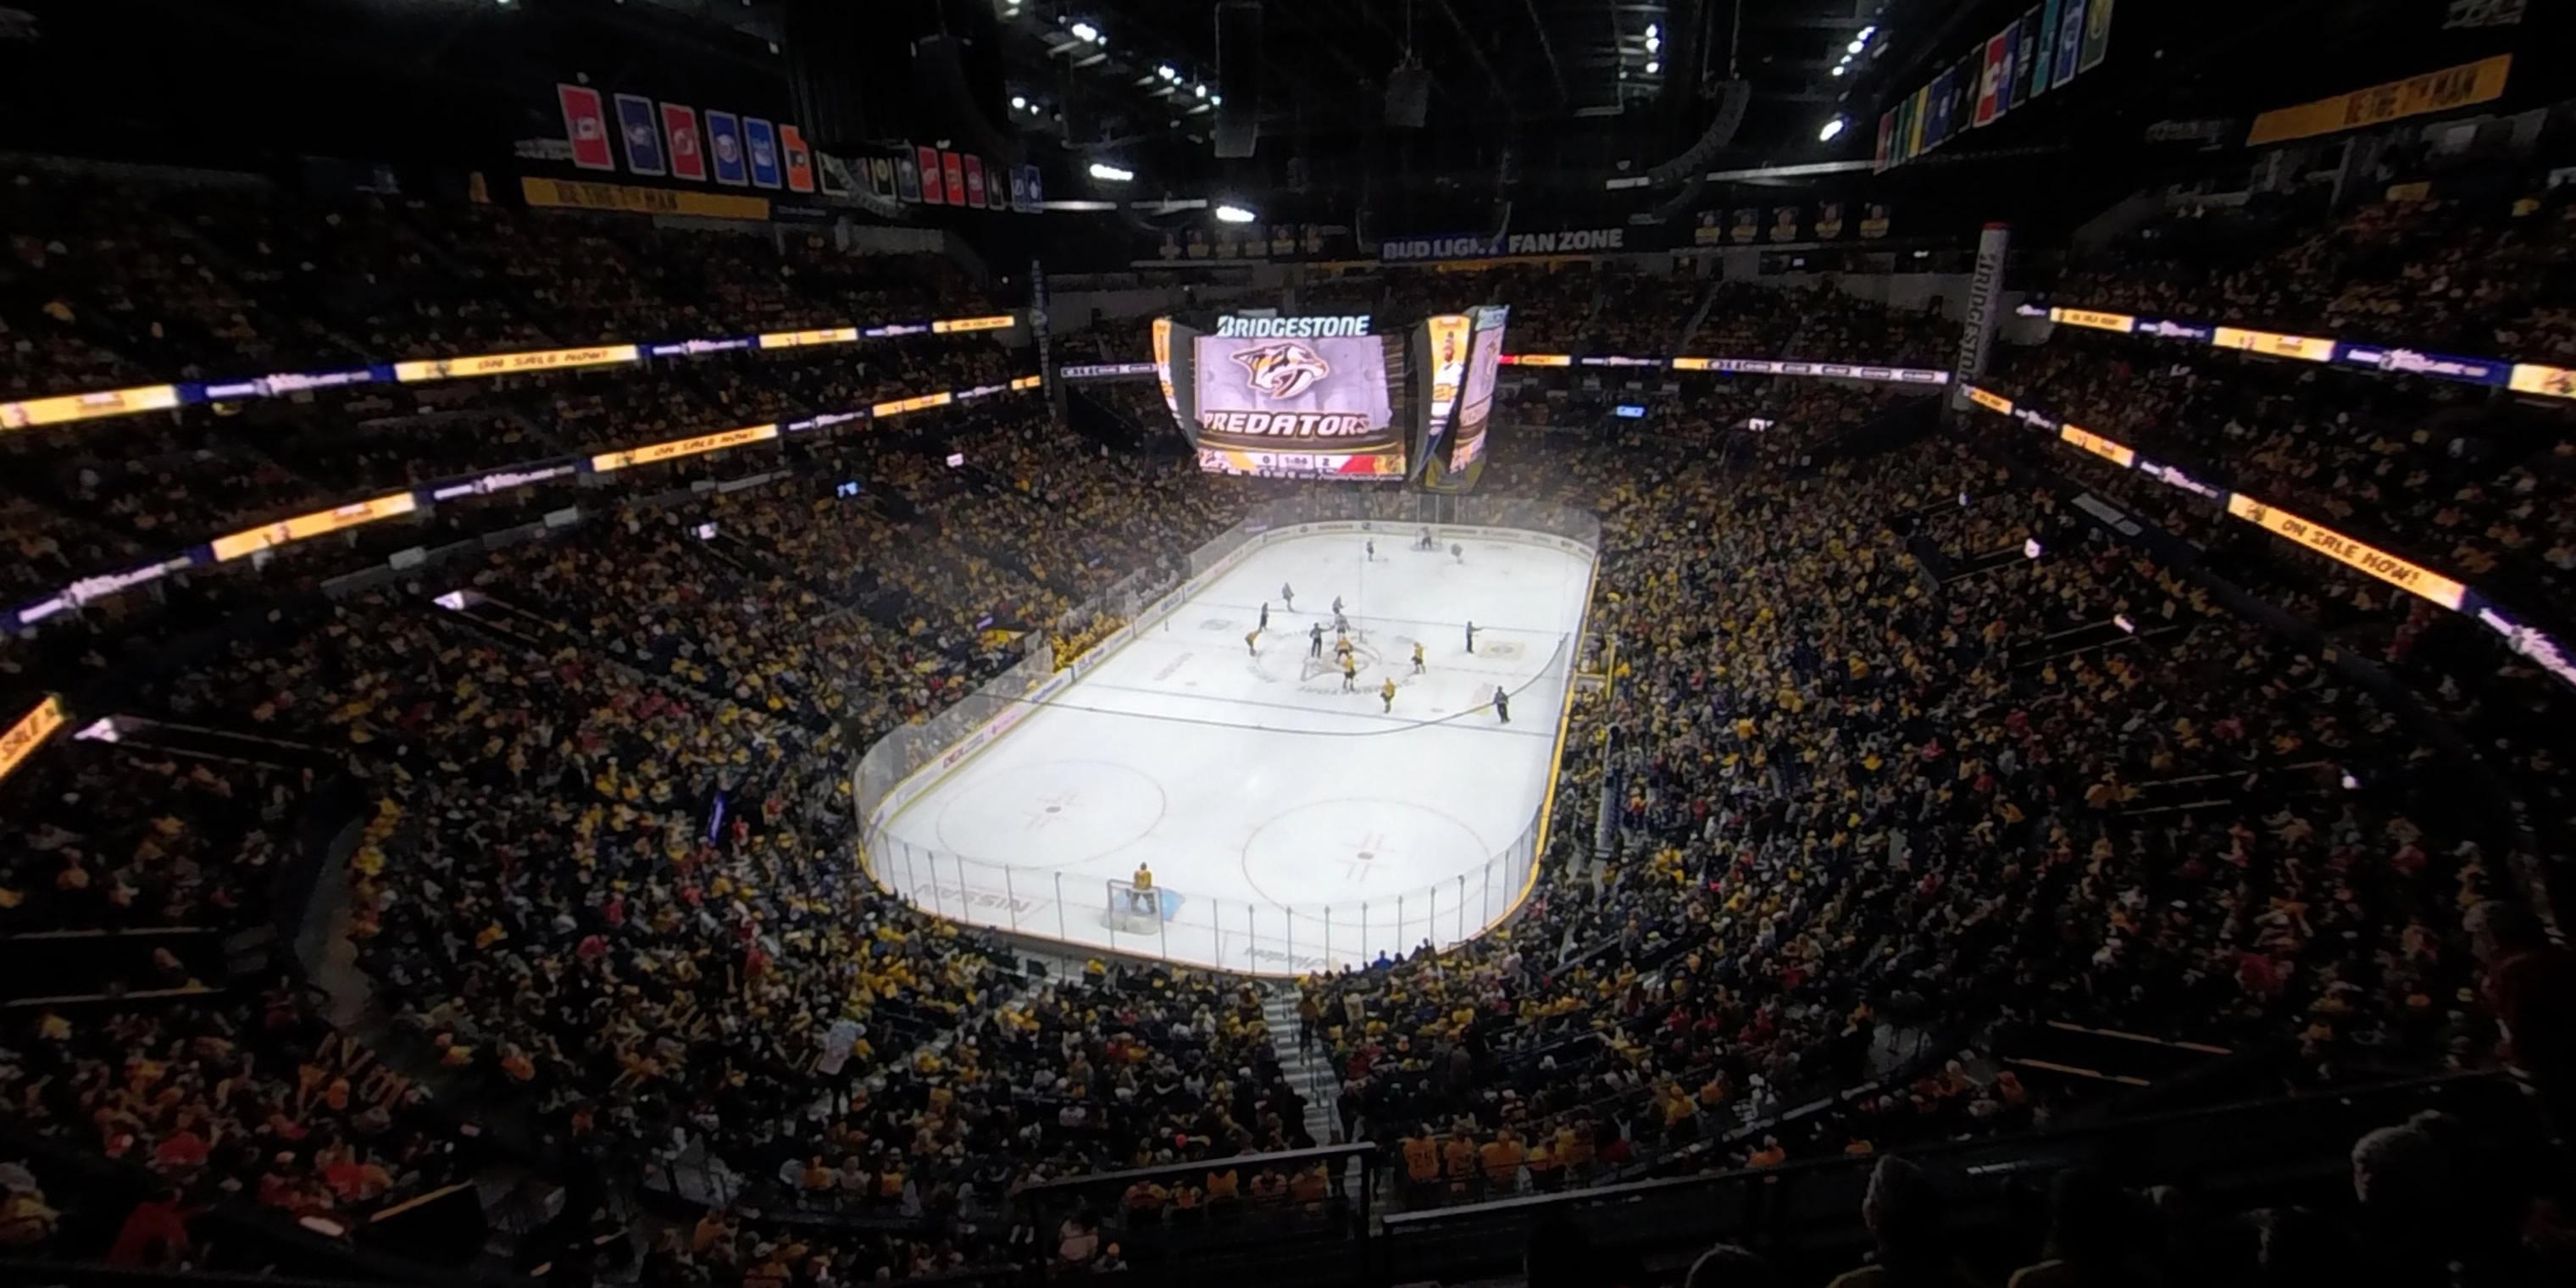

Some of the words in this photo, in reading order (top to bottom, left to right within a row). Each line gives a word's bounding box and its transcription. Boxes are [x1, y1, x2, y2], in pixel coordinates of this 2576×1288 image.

[1383, 241, 1430, 259] BUD
[1433, 236, 1498, 257] LIGH
[1508, 232, 1554, 253] FAN
[1558, 228, 1624, 251] ZONE
[1217, 314, 1371, 338] BRIDGESTONE
[513, 354, 557, 369] SALE
[1203, 412, 1371, 436] PREDATORS
[1322, 458, 1330, 467] 2
[2280, 519, 2308, 538] ON
[2310, 530, 2360, 559] SALE
[2360, 552, 2420, 586] NOW!
